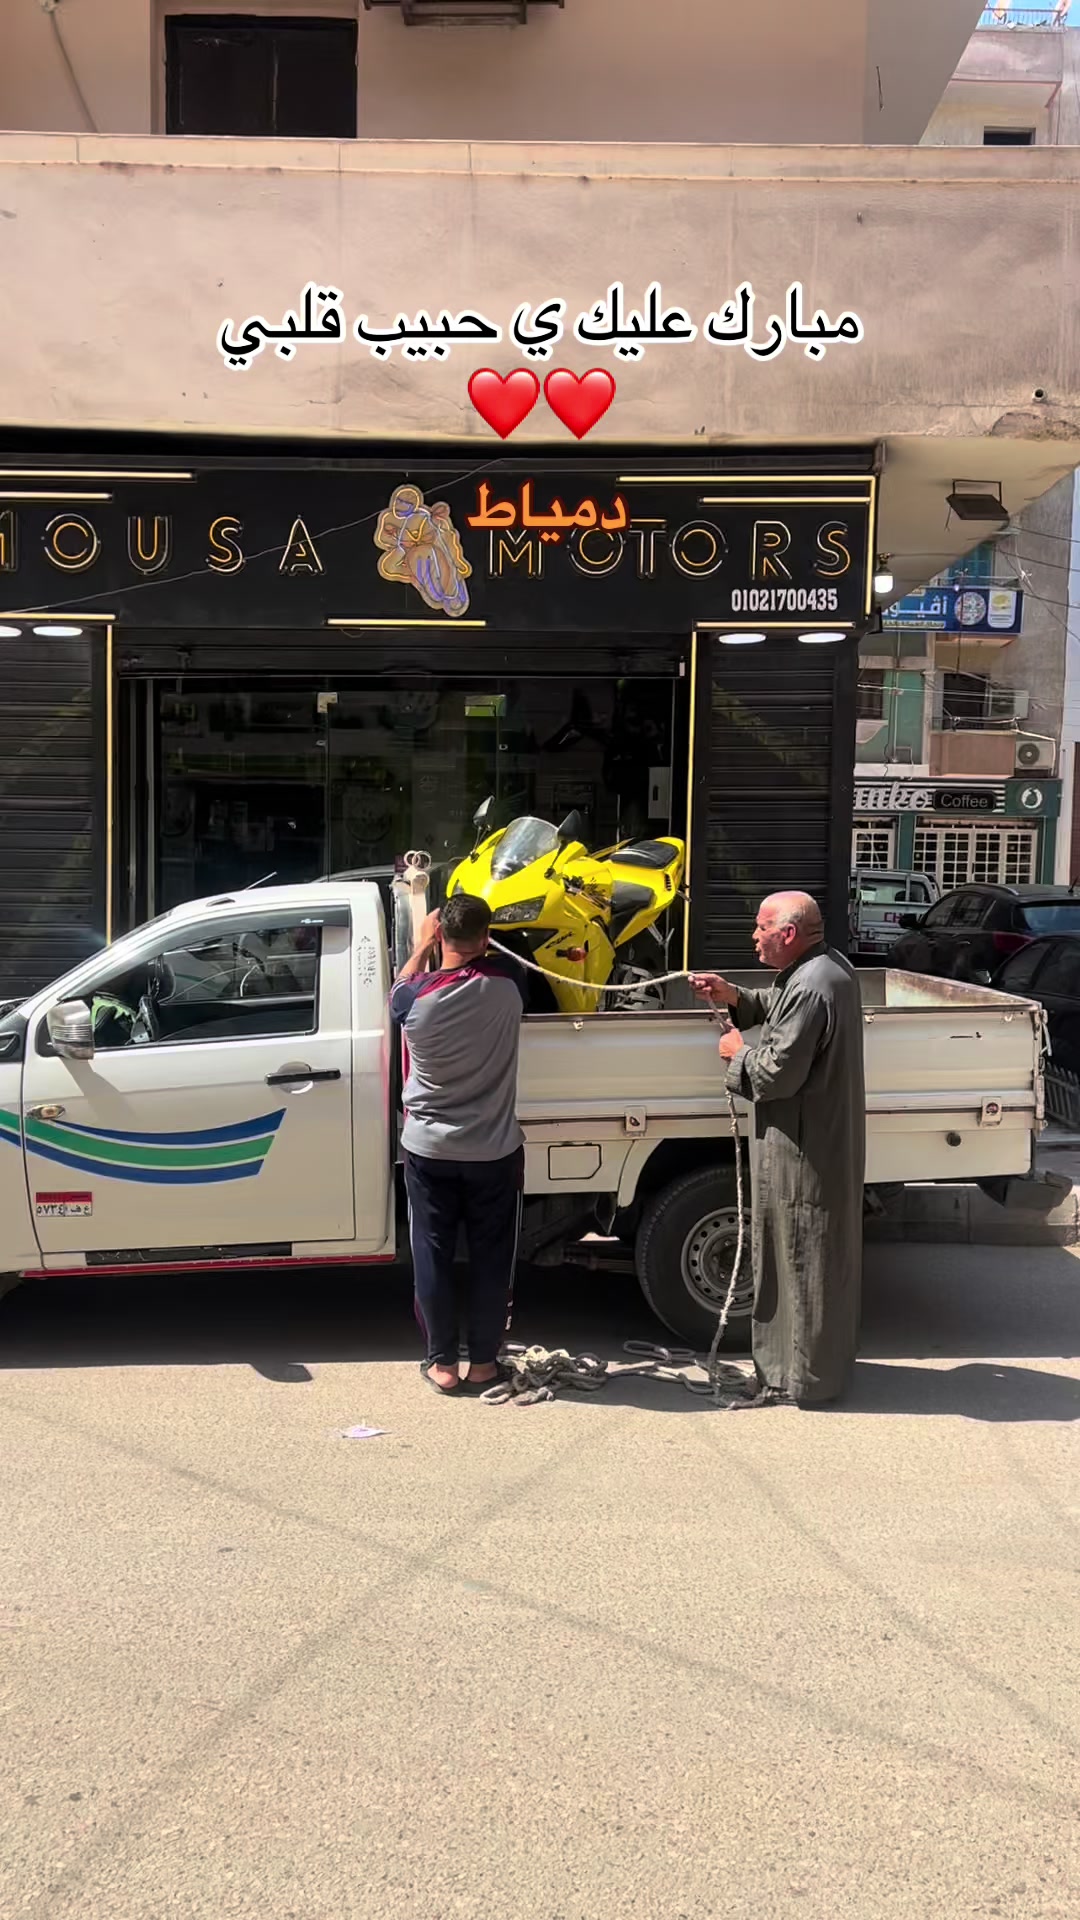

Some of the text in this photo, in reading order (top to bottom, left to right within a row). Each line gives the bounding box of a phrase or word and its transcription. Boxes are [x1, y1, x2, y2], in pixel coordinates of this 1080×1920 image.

[488, 519, 851, 579] MOTORS
[731, 588, 839, 612] 01021700435
[940, 793, 989, 808] Coffee
